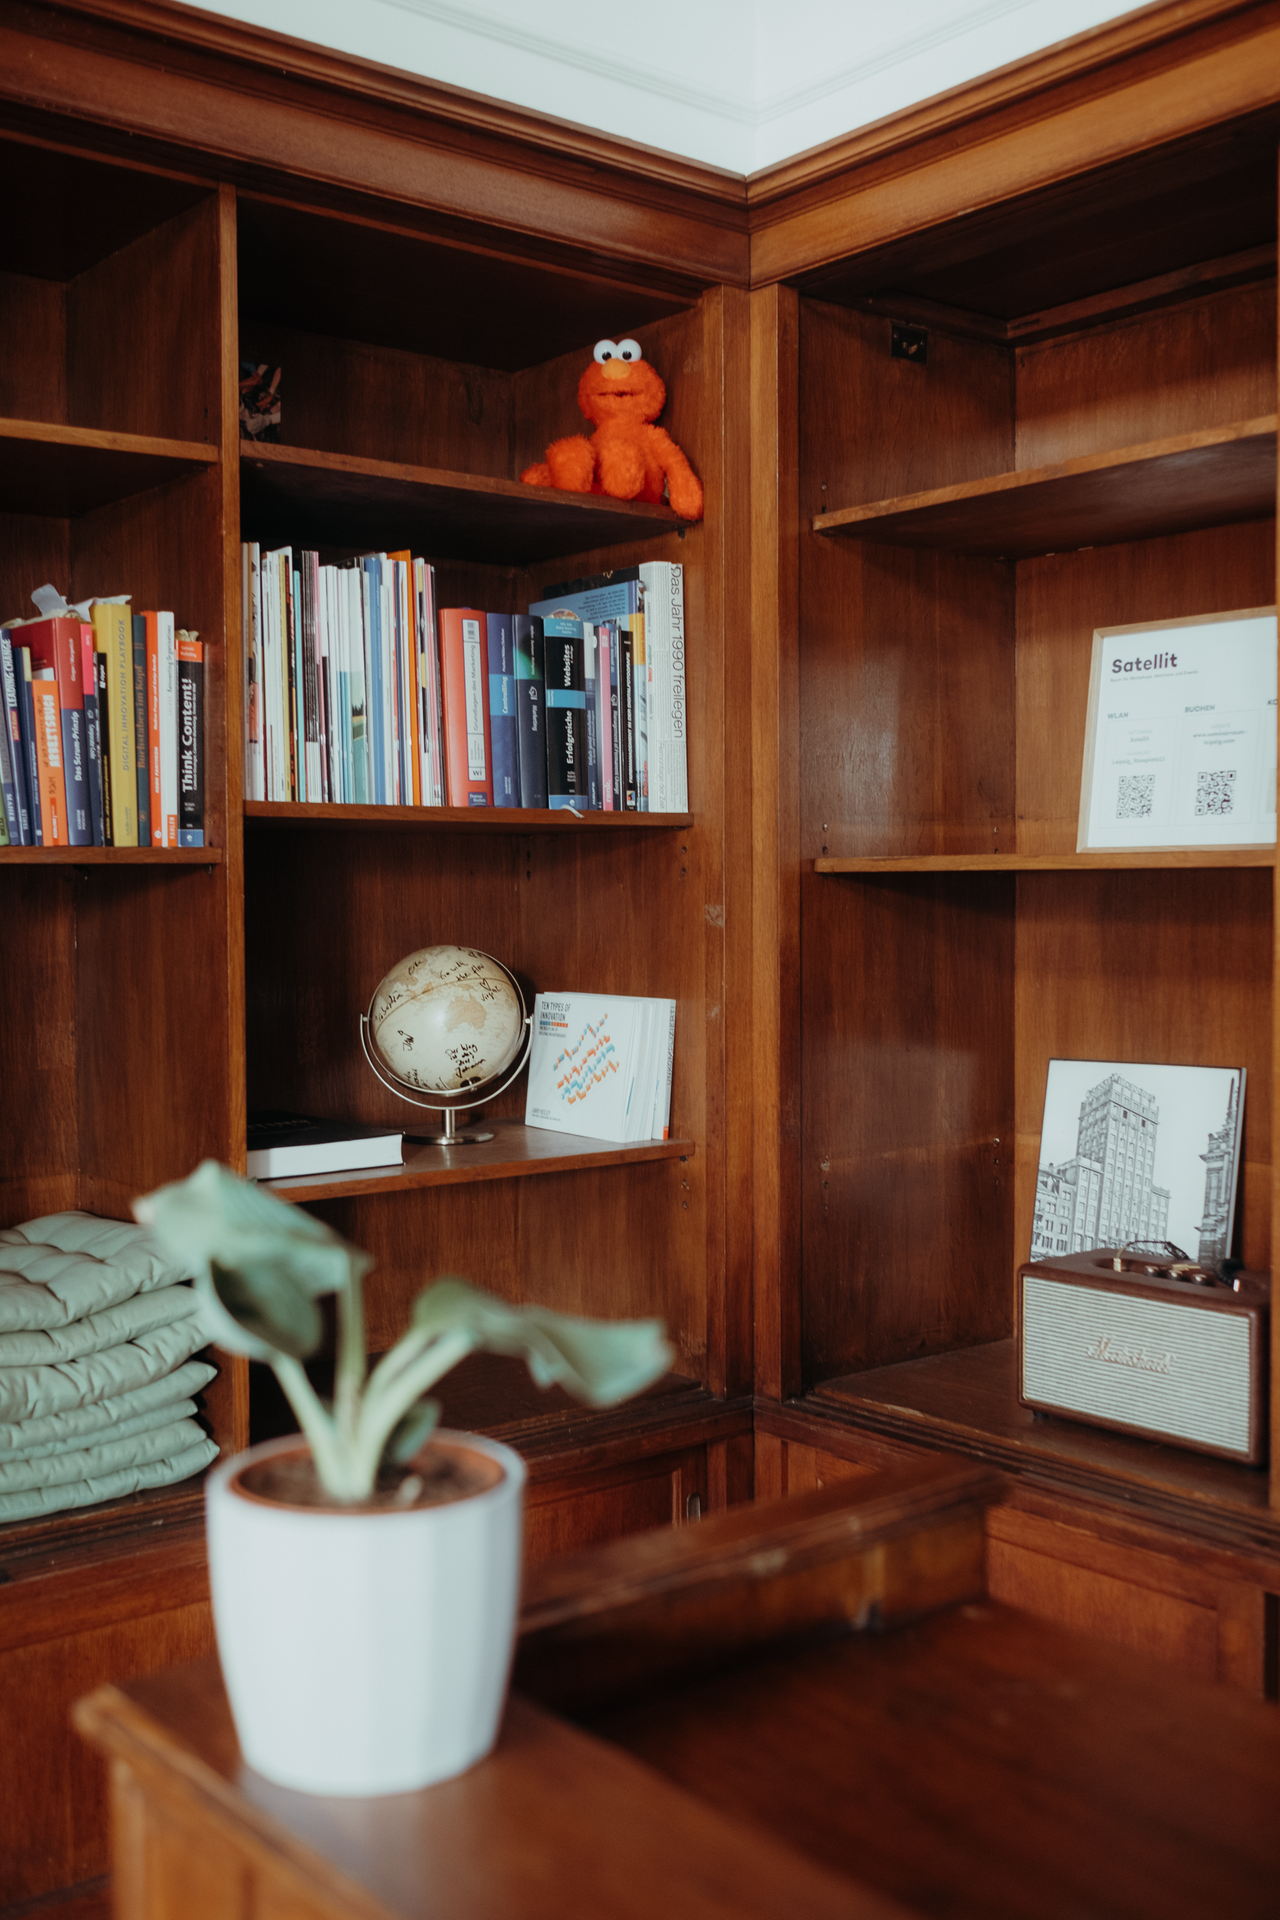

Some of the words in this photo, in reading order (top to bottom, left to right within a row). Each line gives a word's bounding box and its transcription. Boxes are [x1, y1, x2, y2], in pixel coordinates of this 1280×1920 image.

[671, 567, 683, 595] Das
[671, 597, 683, 631] Jahr
[2, 638, 14, 671] CHANGE
[118, 619, 126, 669] PLAYBOOK
[166, 624, 174, 661] Organizations
[671, 634, 684, 671] 1990
[134, 664, 145, 690] Kopf
[469, 644, 477, 679] Marketing
[562, 644, 571, 687] Websites
[1111, 651, 1178, 673] Satellit
[5, 673, 18, 707] LEADING
[119, 672, 128, 732] INNOVATION
[135, 692, 144, 706] im
[501, 676, 509, 714] Controlling
[671, 675, 685, 738] freilegen
[181, 678, 193, 747] Content!
[471, 692, 479, 731] Grundlagen
[612, 710, 620, 742] Management
[1107, 711, 1129, 719] WLAN
[1184, 704, 1215, 713] BUCHEN
[43, 695, 60, 767] ARBEITSBUCH
[71, 711, 82, 765] Scrum-Prinzip
[136, 708, 145, 769] Buchstaben
[564, 709, 575, 764] Erfolgreiche
[121, 735, 130, 771] DIGITAL
[74, 766, 83, 782] Das
[181, 750, 193, 793] Think
[168, 816, 176, 840] VAHLEN
[540, 1011, 566, 1021] INNOVATION
[541, 1001, 550, 1010] TEN
[550, 1002, 564, 1012] TYPES
[565, 1003, 571, 1012] OF
[460, 1043, 478, 1053] Weg
[1086, 1333, 1177, 1374] Marshall
